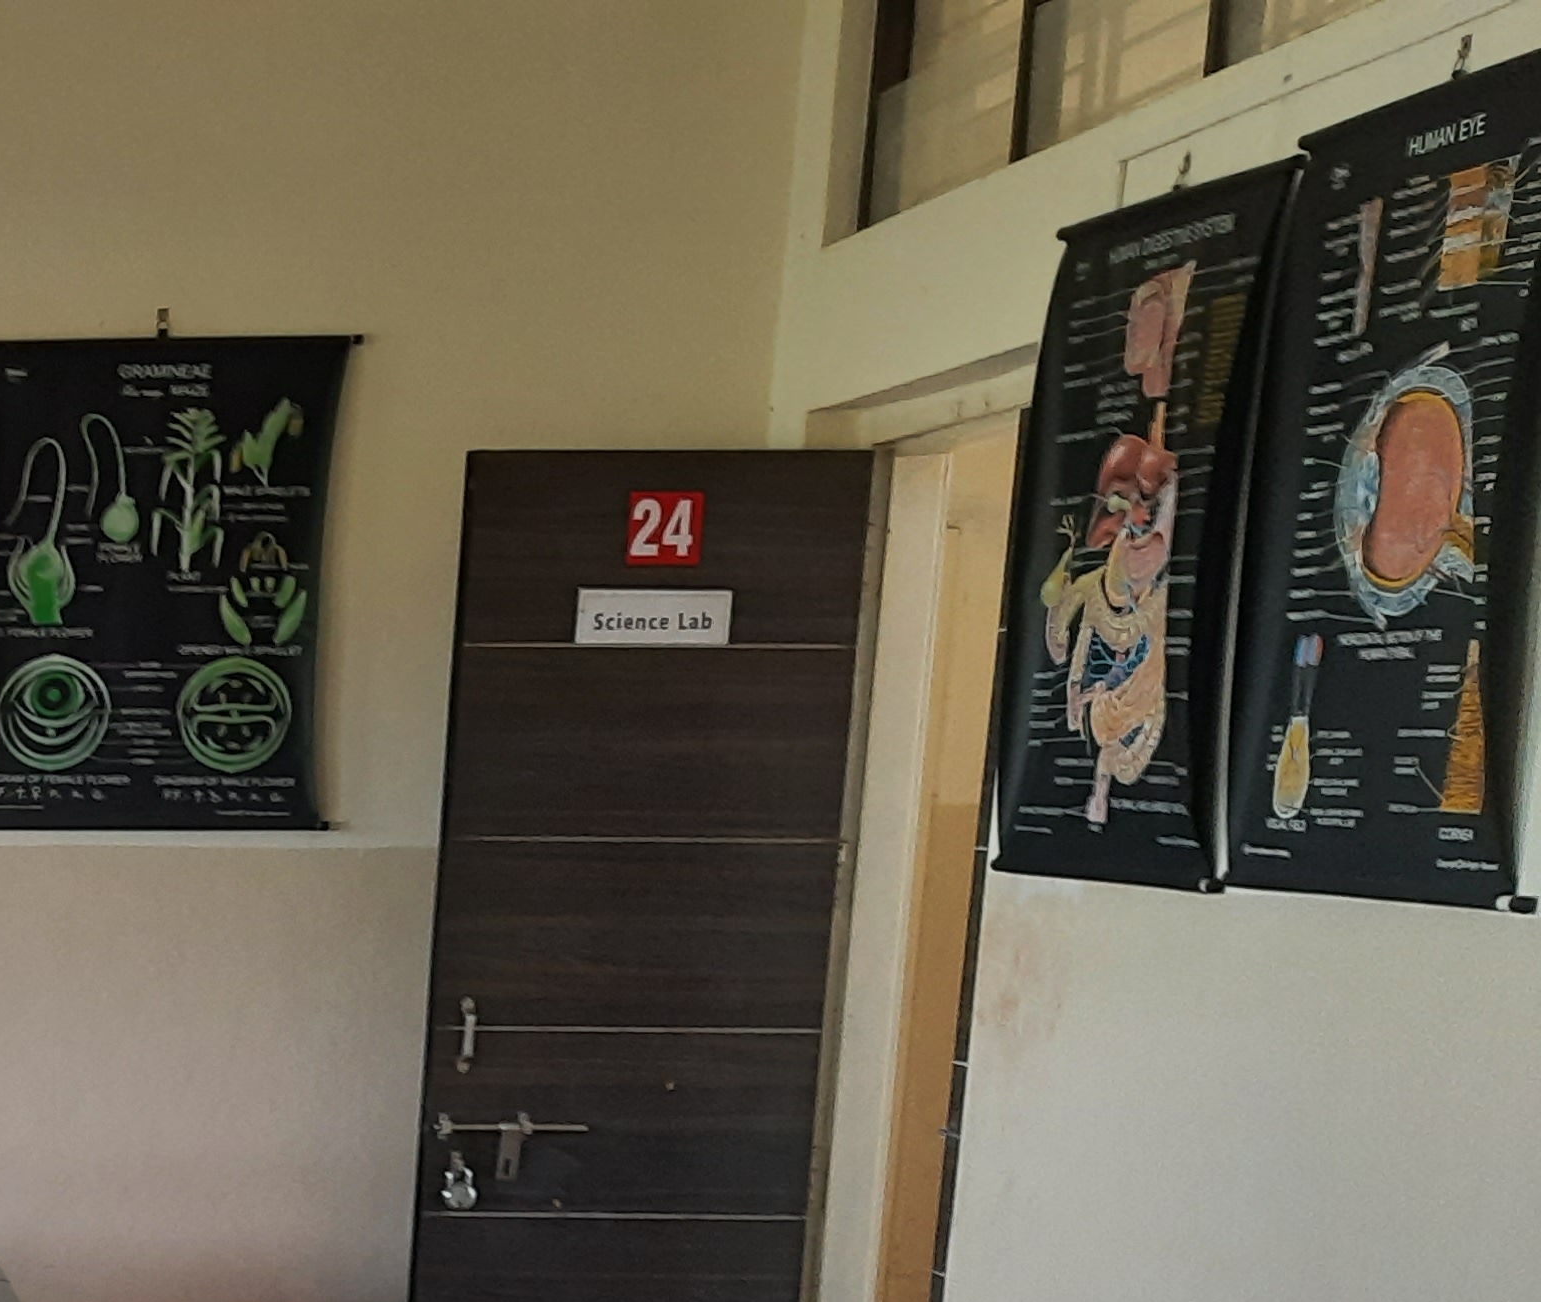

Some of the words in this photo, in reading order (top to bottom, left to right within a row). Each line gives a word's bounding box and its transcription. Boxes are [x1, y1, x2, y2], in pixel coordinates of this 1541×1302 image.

[1407, 122, 1456, 157] HUMAN
[1458, 112, 1487, 141] EYE
[629, 498, 694, 557] 24
[593, 612, 669, 631] Science
[678, 612, 712, 631] Lab
